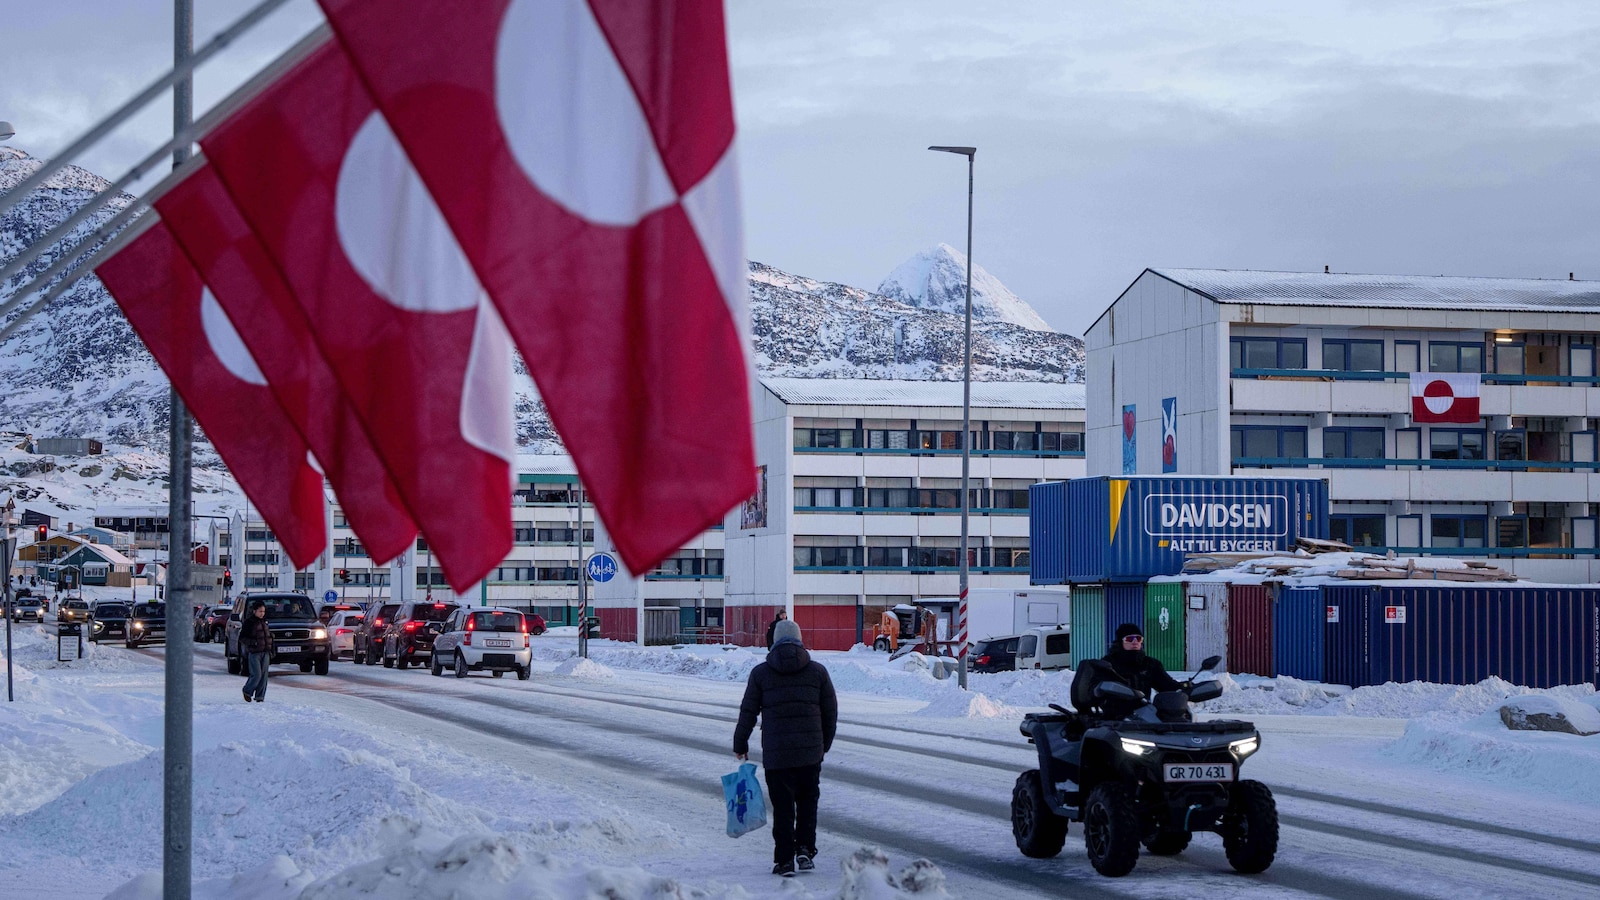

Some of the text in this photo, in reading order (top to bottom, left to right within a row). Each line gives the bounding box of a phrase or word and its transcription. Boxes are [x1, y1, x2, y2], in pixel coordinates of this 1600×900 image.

[1161, 503, 1271, 528] DAVIDSEN
[1170, 540, 1276, 552] ALT TIL BYGGERI
[1170, 766, 1226, 779] GR 70 431
